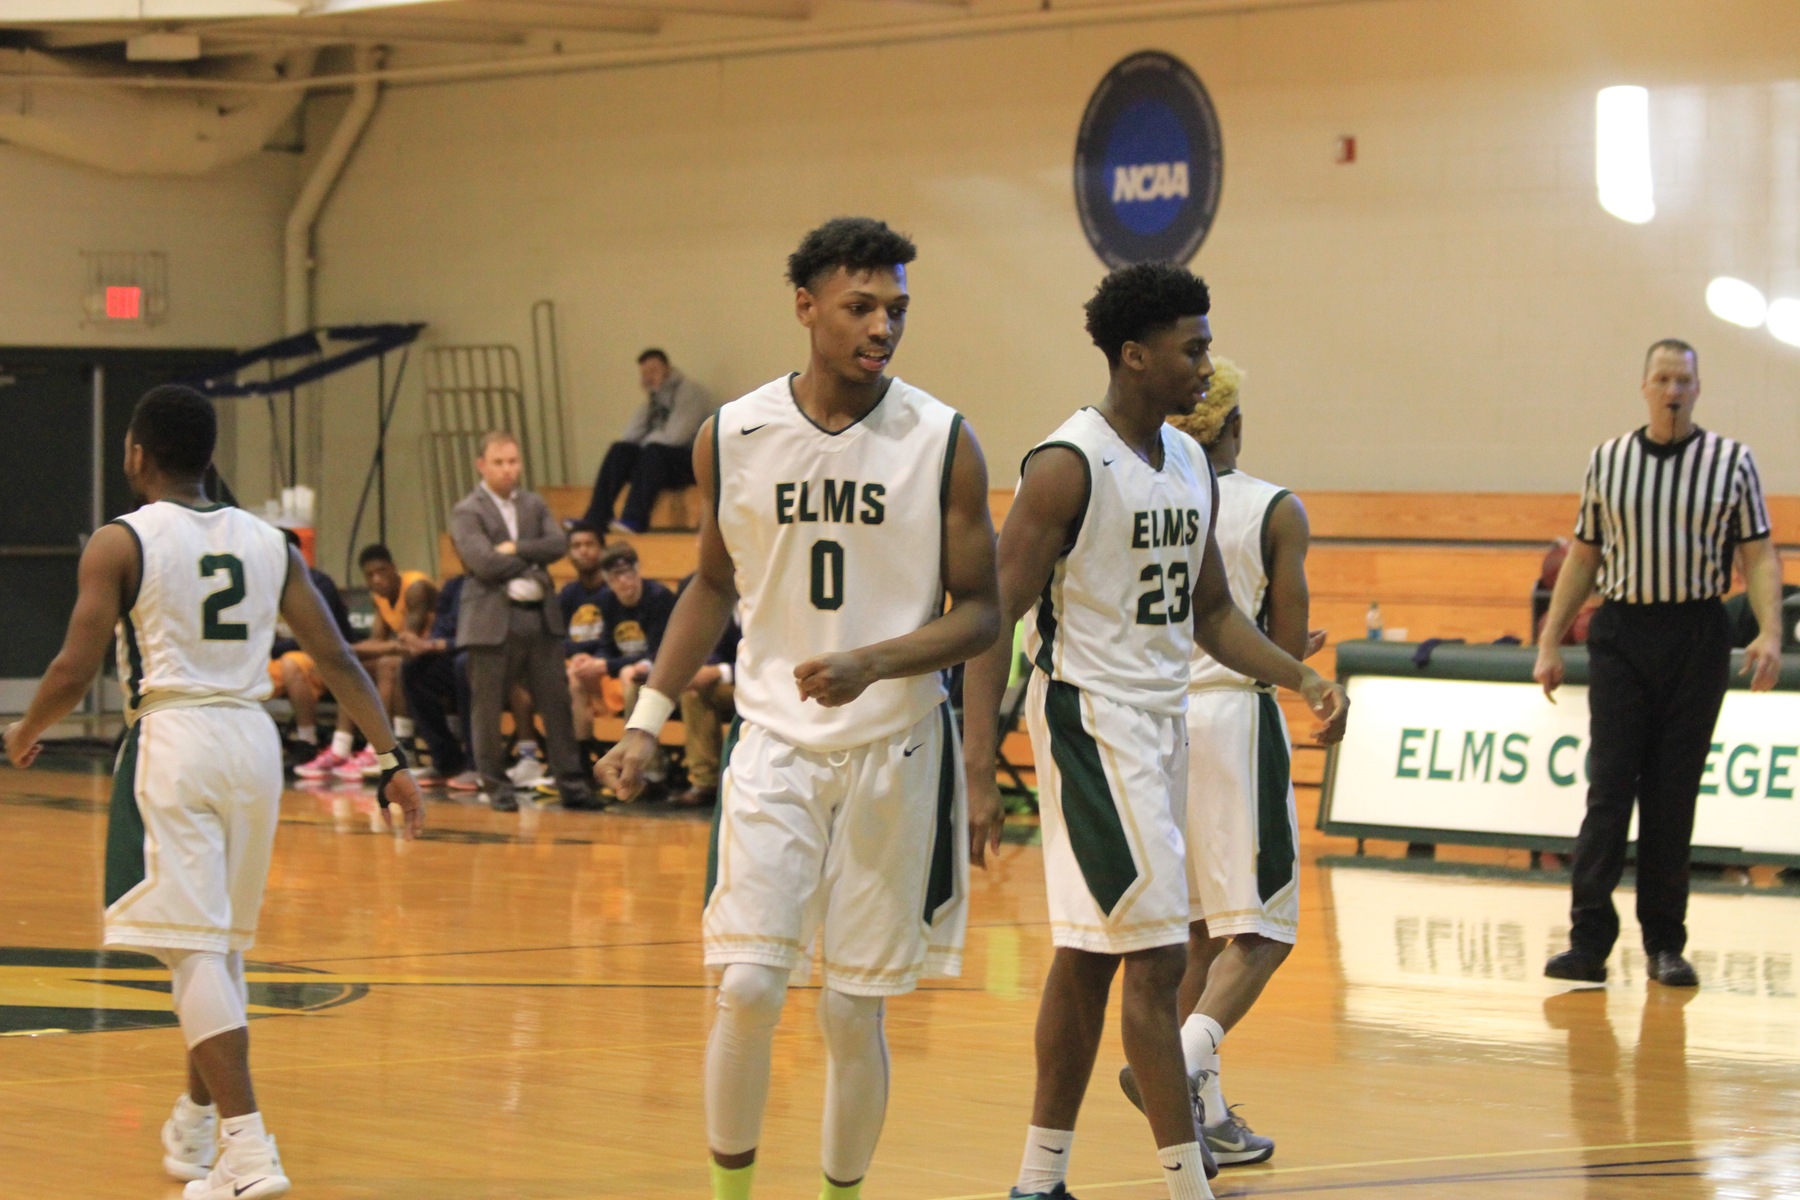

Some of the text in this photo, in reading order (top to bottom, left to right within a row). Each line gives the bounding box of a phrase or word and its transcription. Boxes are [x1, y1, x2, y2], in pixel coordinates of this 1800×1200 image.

[1112, 161, 1190, 203] NCAA
[776, 479, 886, 525] ELMS
[1132, 508, 1200, 549] ELMS
[200, 553, 248, 641] 2
[811, 539, 844, 611] 0
[1136, 561, 1191, 625] 23
[1395, 727, 1799, 800] ELMS CEGE
